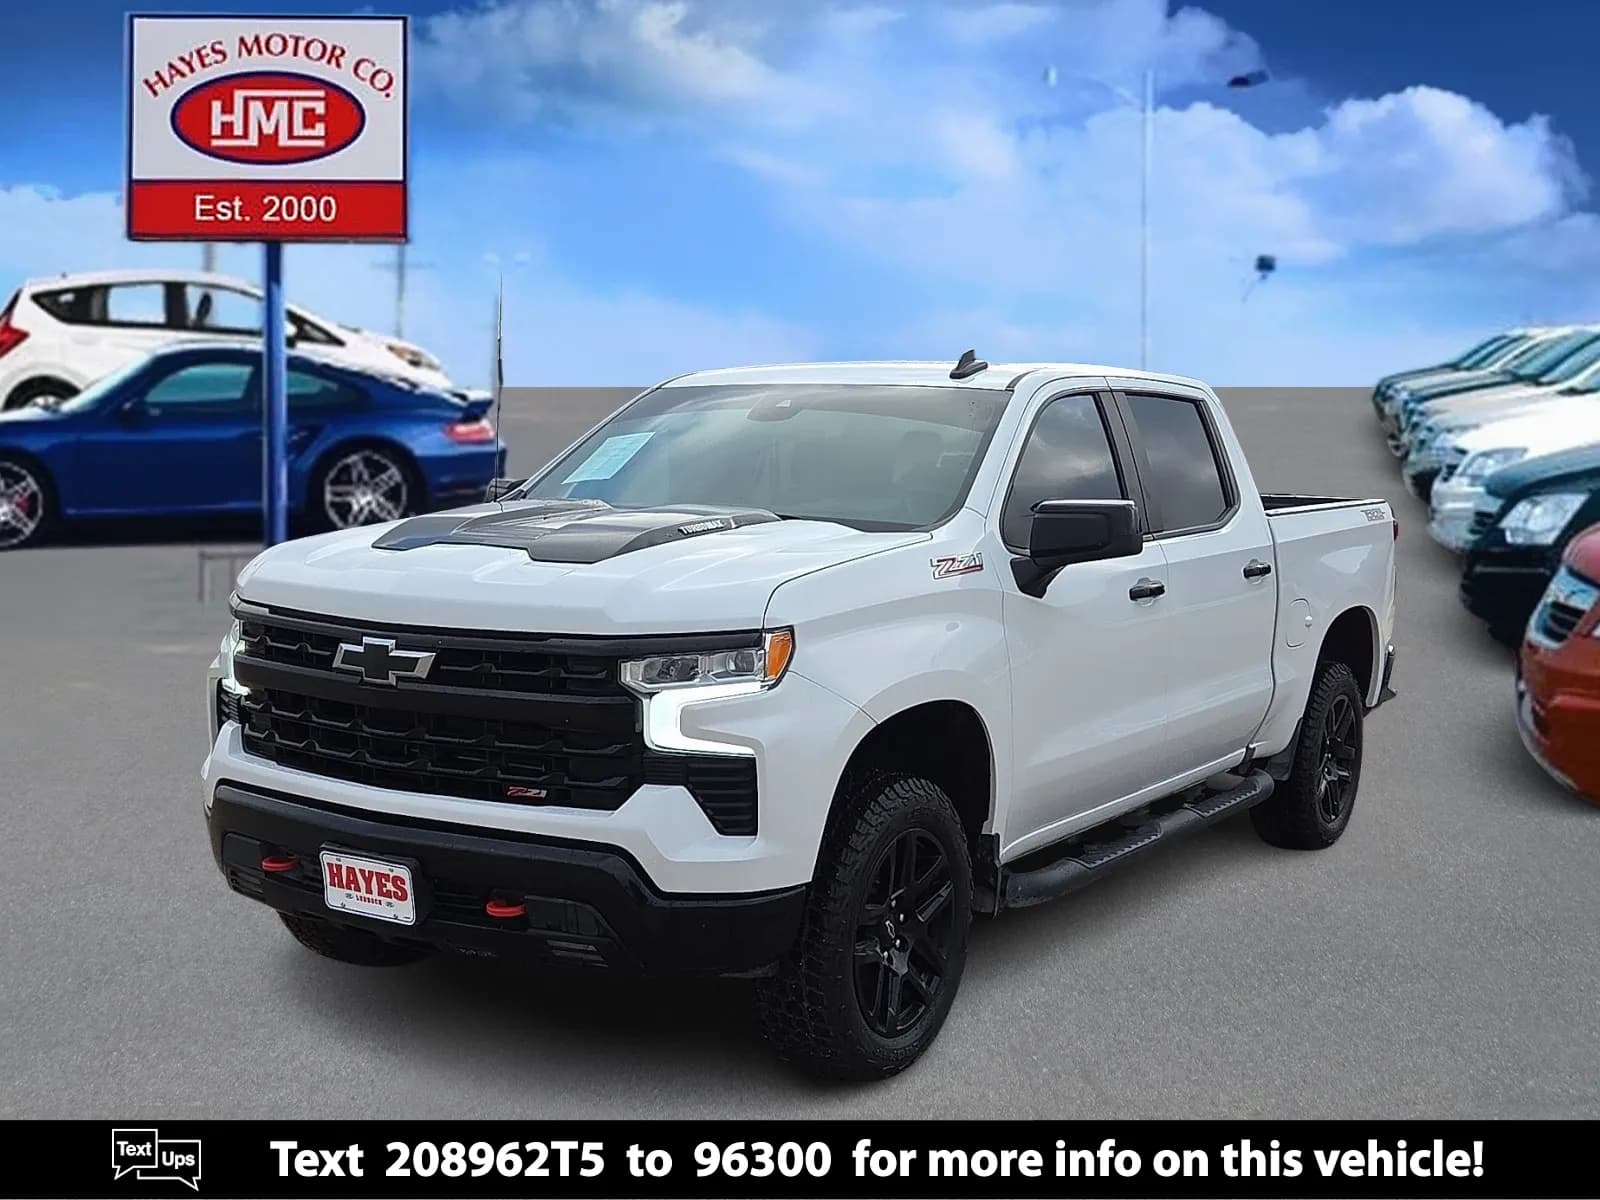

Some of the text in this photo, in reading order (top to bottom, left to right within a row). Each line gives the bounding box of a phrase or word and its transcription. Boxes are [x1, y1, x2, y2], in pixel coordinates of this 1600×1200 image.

[143, 33, 394, 99] HAYES MOTOR CO.
[211, 89, 326, 147] HMC
[194, 194, 337, 222] Est. 2000
[326, 862, 408, 902] HAYES
